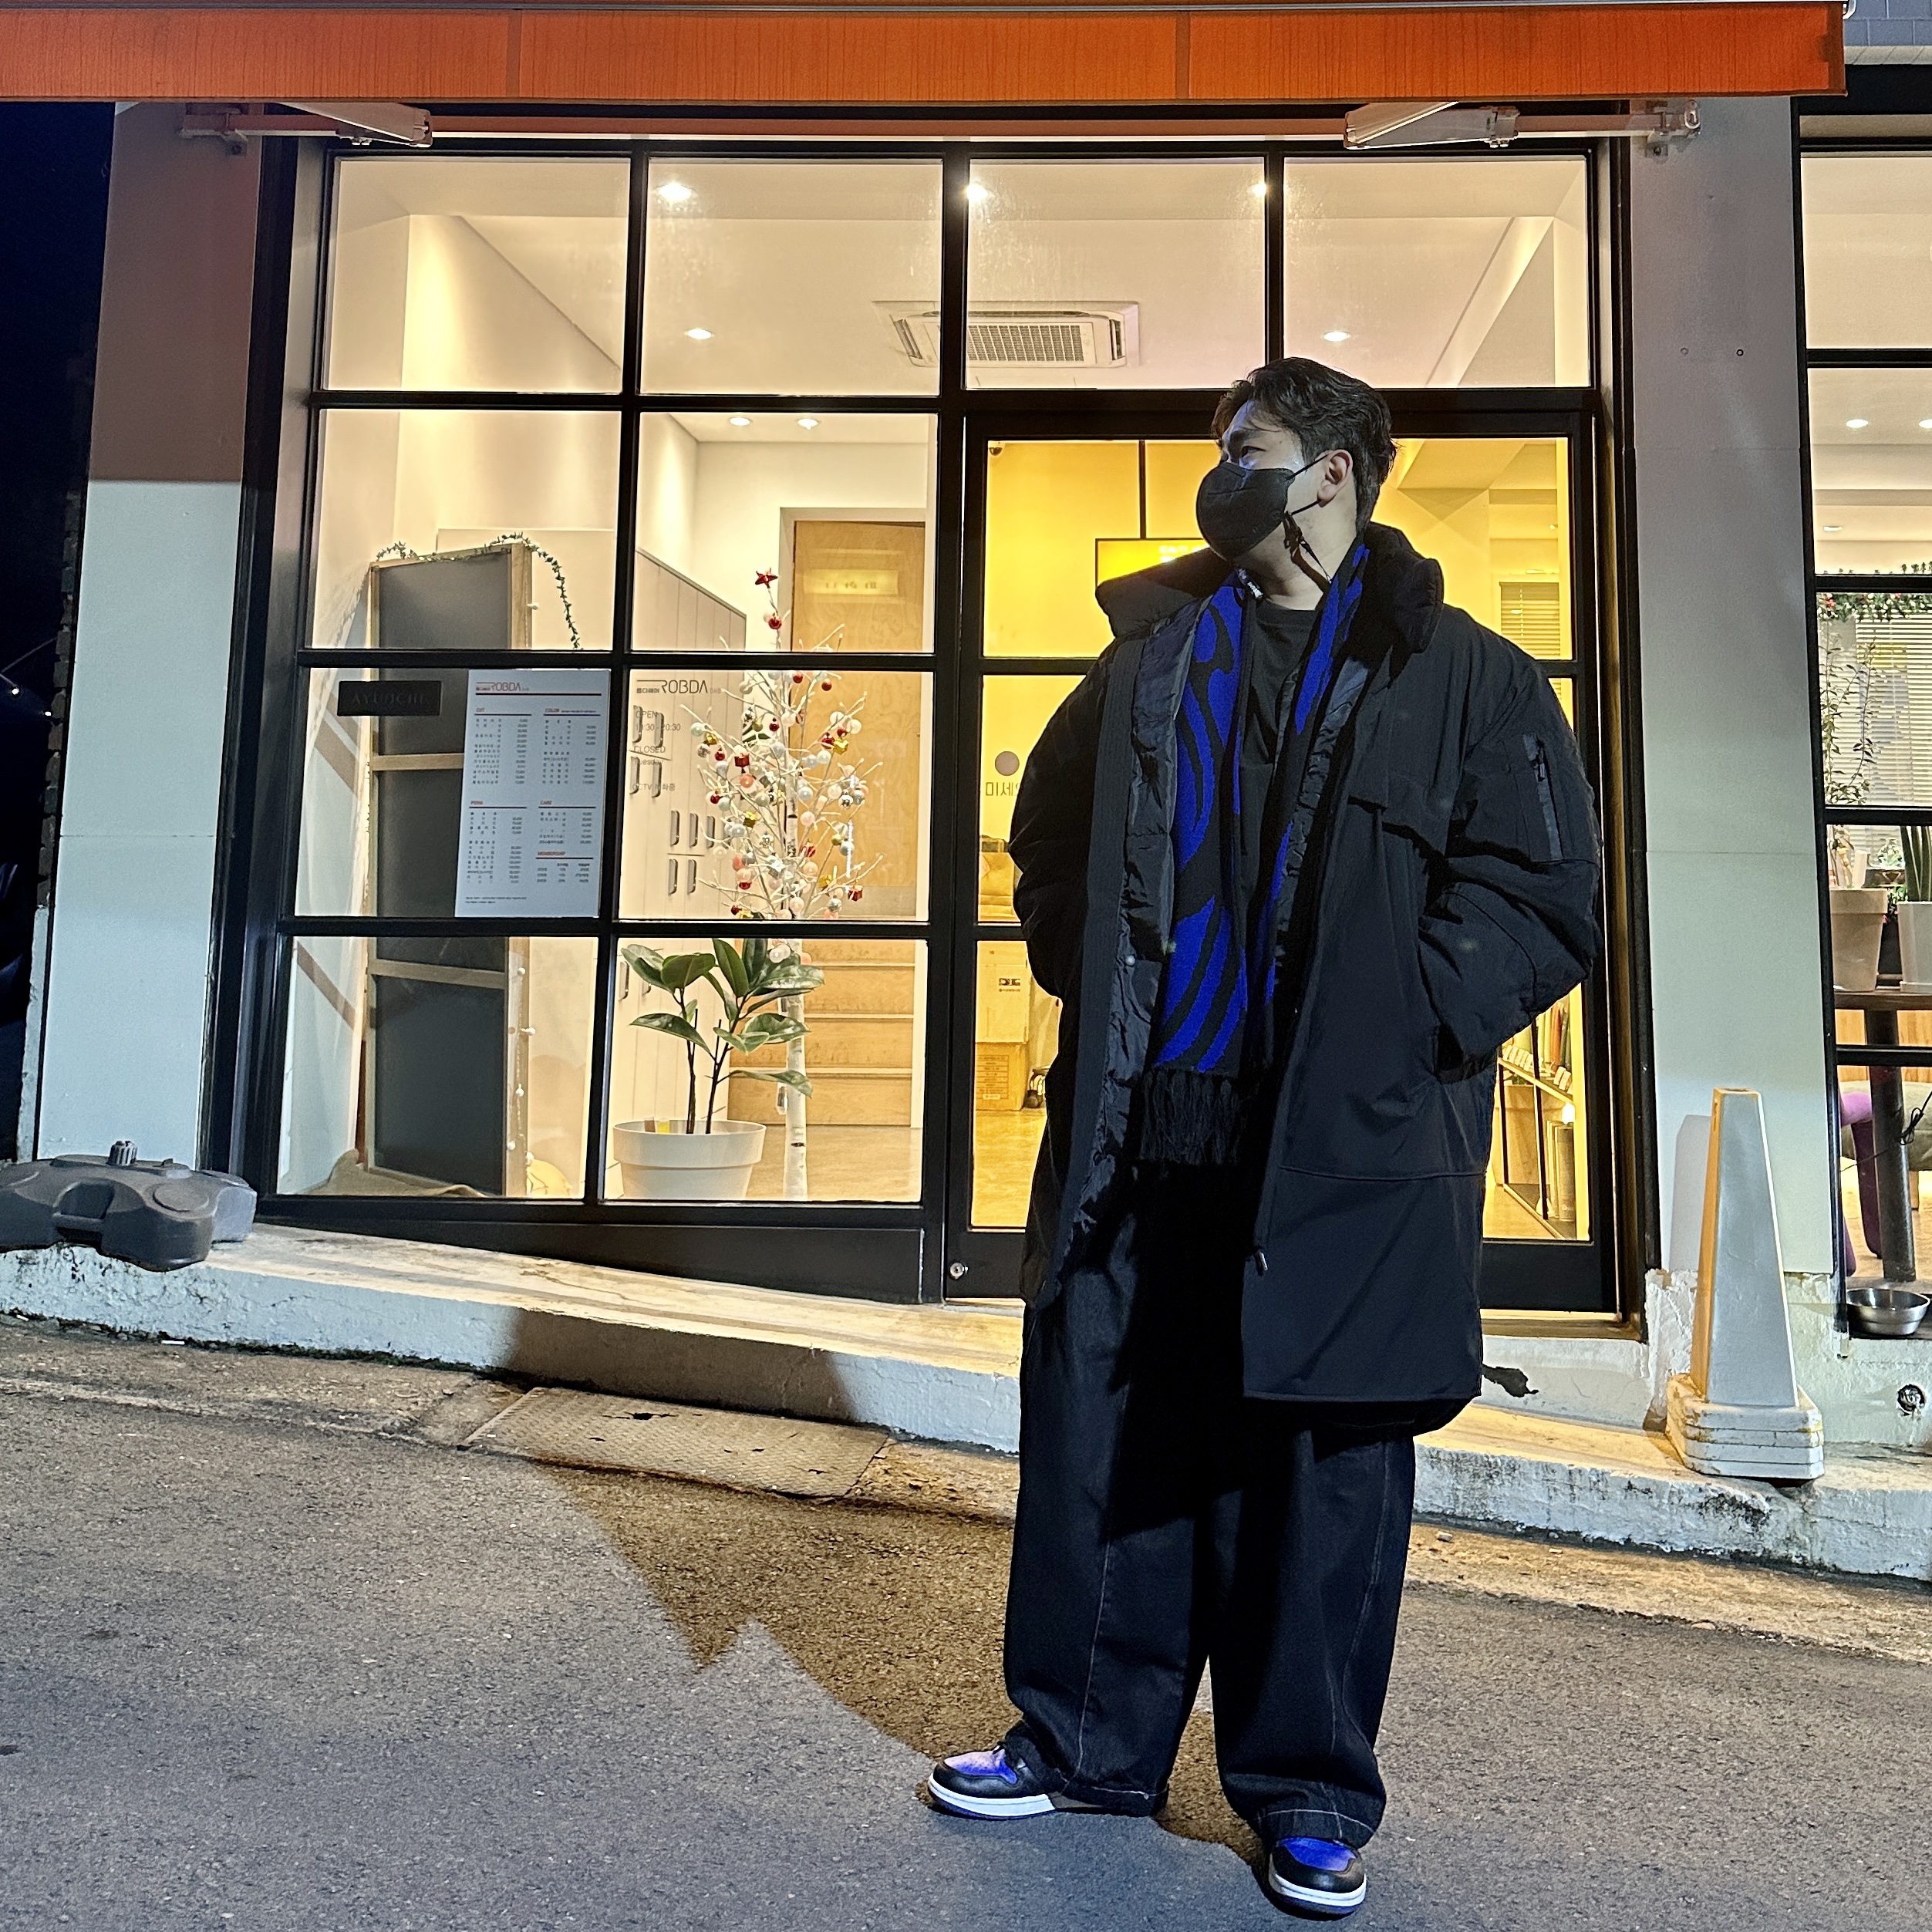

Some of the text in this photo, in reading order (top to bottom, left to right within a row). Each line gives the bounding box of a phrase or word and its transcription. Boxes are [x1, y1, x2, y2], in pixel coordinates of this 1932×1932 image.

[476, 681, 521, 692] ROBDA
[636, 679, 709, 694] ROBDA
[633, 745, 666, 754] CLOSED
